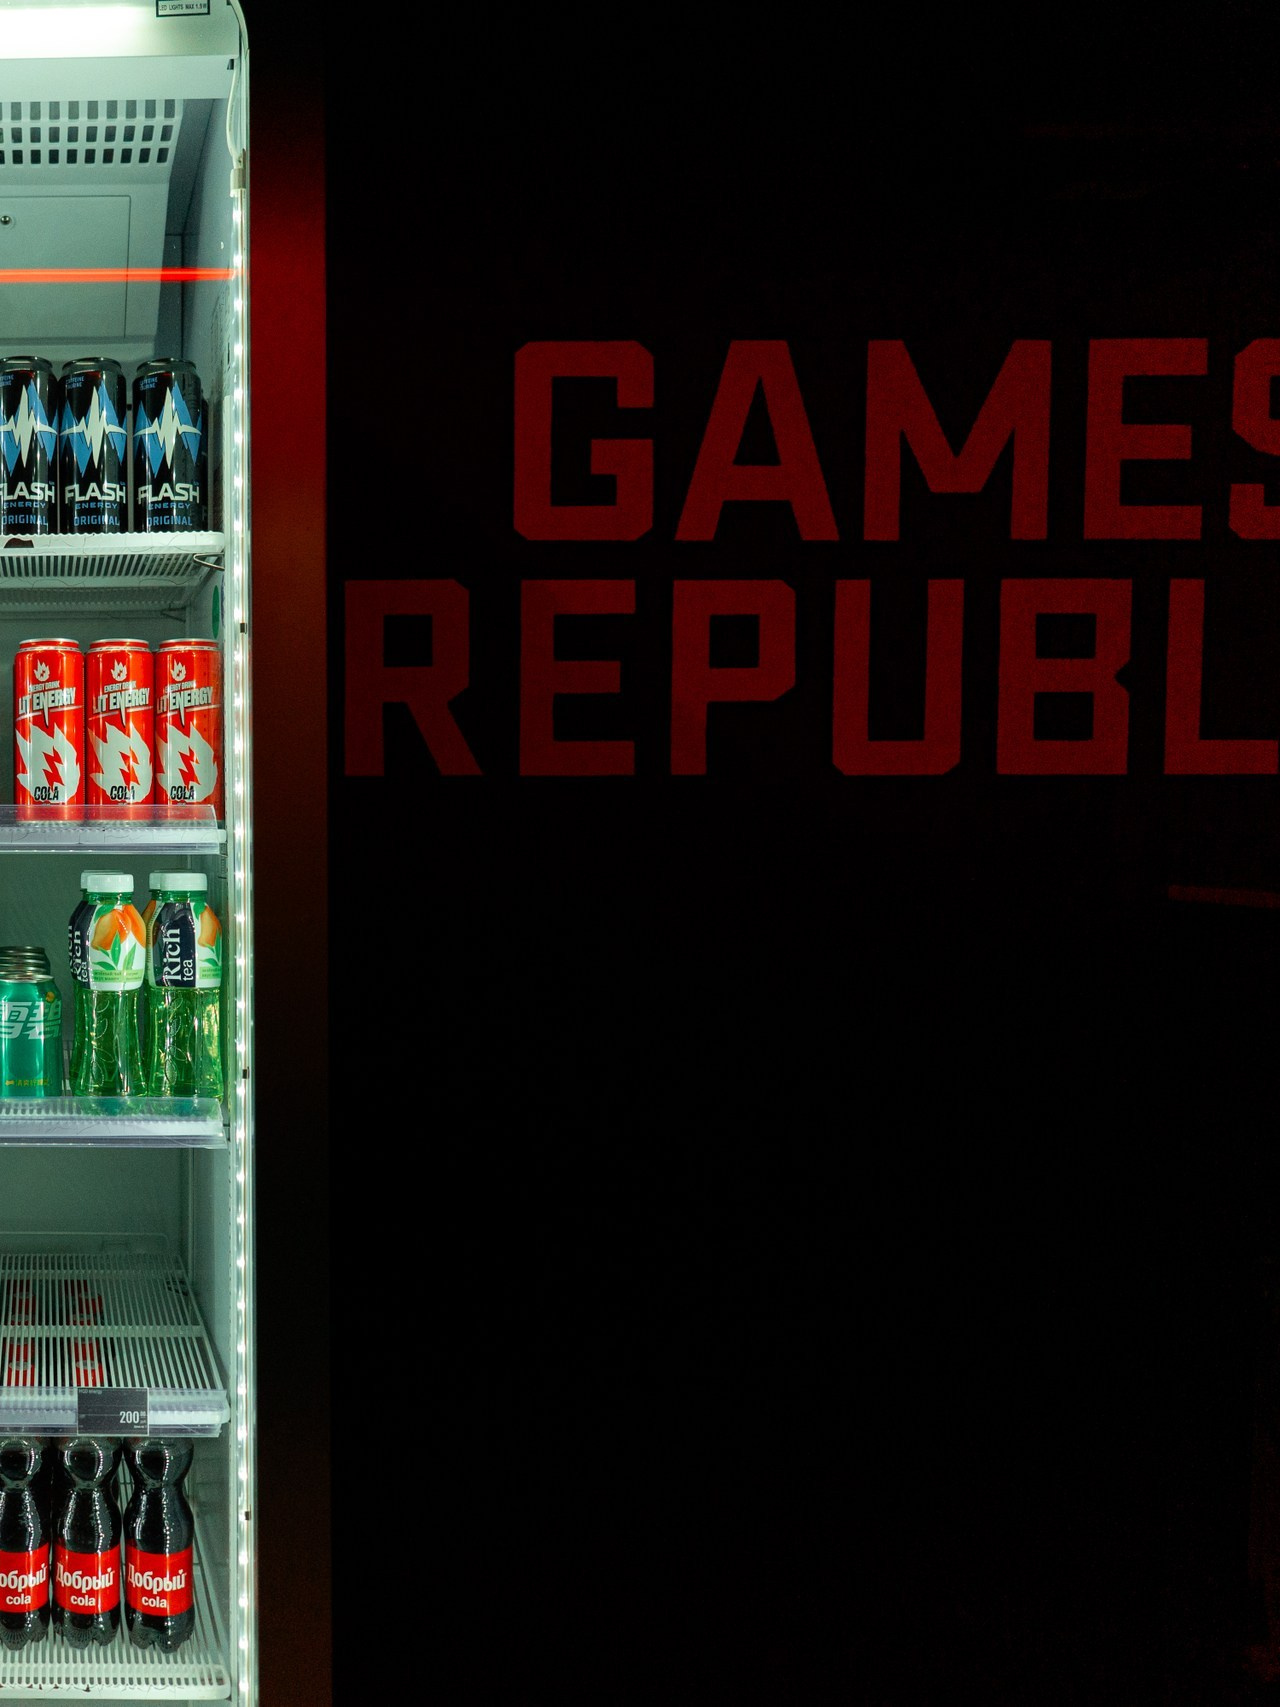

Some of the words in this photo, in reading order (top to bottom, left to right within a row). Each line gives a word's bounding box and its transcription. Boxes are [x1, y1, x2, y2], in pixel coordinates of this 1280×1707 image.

[64, 482, 127, 504] FLASH
[138, 482, 200, 505] FLASH
[3, 501, 46, 509] ENERGY
[75, 502, 118, 510] ENERGY
[148, 502, 191, 510] ENERGY
[2, 514, 49, 526] ORIGINAL
[73, 514, 120, 526] ORIGINAL
[147, 514, 193, 526] ORIGINAL
[32, 687, 76, 724] ENERGY
[109, 687, 150, 724] ENERGY
[170, 686, 213, 724] ENERGY
[34, 786, 59, 801] COLA
[110, 785, 135, 800] COLA
[170, 785, 195, 800] COLA
[163, 928, 181, 981] Rich
[182, 959, 194, 982] tea
[120, 1411, 140, 1424] 200
[56, 1562, 115, 1593] Добрый
[128, 1562, 187, 1595] Добрый
[6, 1593, 32, 1606] cola
[70, 1595, 96, 1607] cola
[141, 1596, 168, 1609] cola
